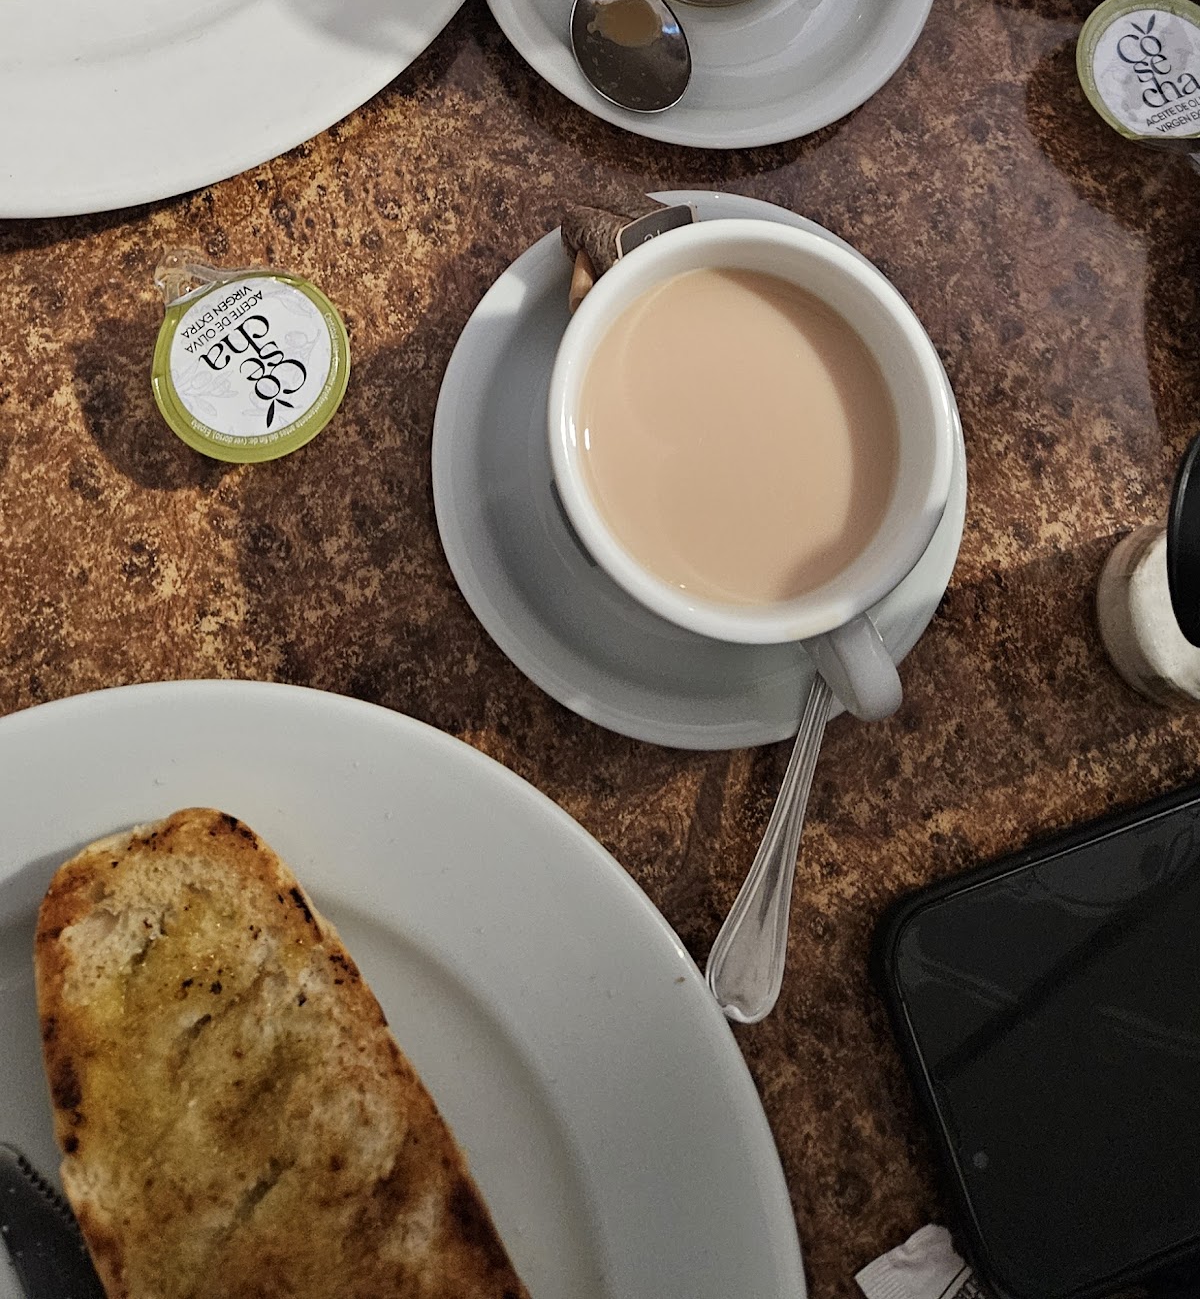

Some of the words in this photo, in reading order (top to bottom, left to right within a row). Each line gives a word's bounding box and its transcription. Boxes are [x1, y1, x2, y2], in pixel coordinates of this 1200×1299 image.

[1146, 106, 1176, 127] ACEITE
[1174, 102, 1189, 113] DE
[1156, 114, 1192, 133] VIRGEN
[213, 285, 253, 316] VIRGEN
[232, 290, 263, 320] ACEITE
[180, 311, 214, 339] EXTRA
[218, 318, 232, 332] DE
[184, 328, 217, 354] OLIVA
